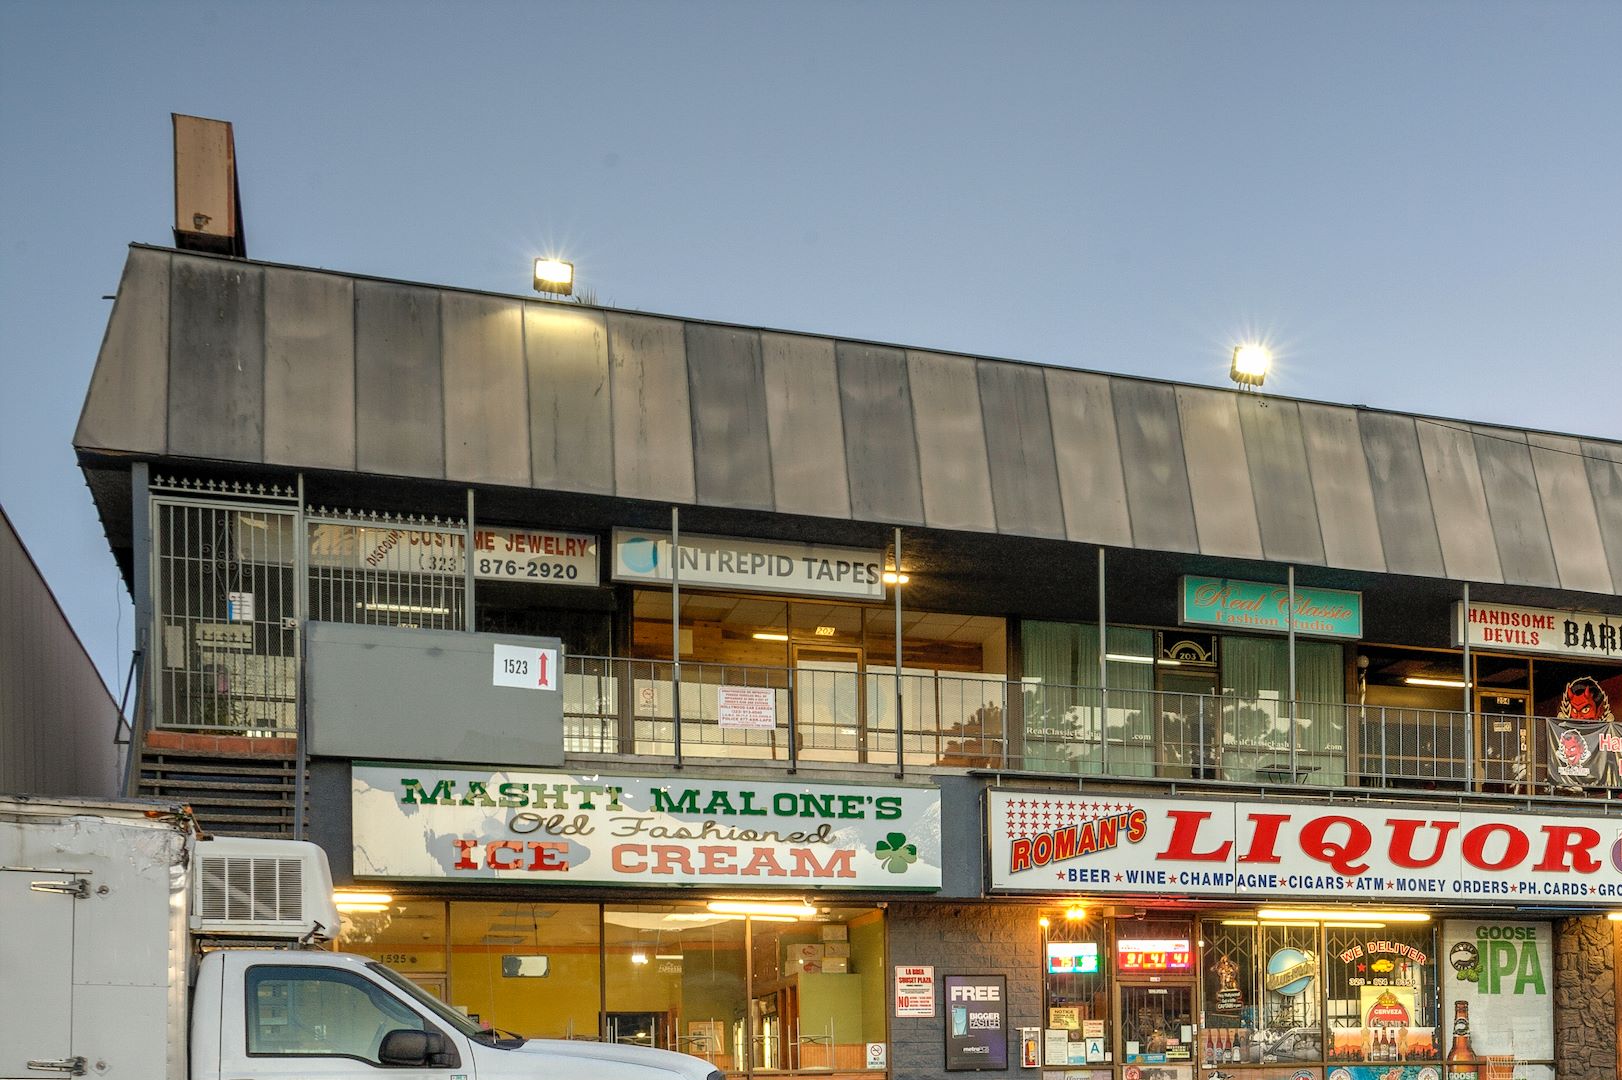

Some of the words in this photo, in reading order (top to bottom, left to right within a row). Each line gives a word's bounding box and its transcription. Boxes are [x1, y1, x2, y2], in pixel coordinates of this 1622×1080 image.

[505, 534, 588, 558] JEWELRY
[479, 558, 578, 580] 876-2920
[802, 556, 880, 585] TAPES
[1194, 582, 1267, 612] Real
[1271, 585, 1354, 622] Classic
[1215, 609, 1278, 625] Fashion
[1467, 608, 1555, 630] HANDSOME
[1483, 627, 1540, 646] DEVILS
[504, 659, 528, 675] 1523
[1179, 652, 1197, 661] 203
[401, 778, 623, 811] MASHTI
[650, 786, 902, 820] MALONE'S
[509, 812, 596, 836] Old
[609, 816, 837, 845] Fashioned
[1009, 808, 1147, 875] ROMAN'S
[1155, 810, 1602, 876] LIQUOR
[453, 839, 569, 872] ICE
[611, 843, 857, 878] CREAM
[1068, 868, 1111, 883] BEER
[1126, 870, 1166, 885] WINE
[1180, 871, 1277, 888] CHAMPAGNE
[1289, 875, 1344, 890] CIGARS
[1356, 877, 1384, 891] ATM
[1396, 878, 1446, 893] MONEY
[1453, 879, 1509, 894] ORDERS
[1476, 925, 1536, 940] GOOSE
[380, 954, 406, 964] 1525
[1340, 945, 1363, 964] WE
[1367, 940, 1427, 965] DELIVER
[1477, 940, 1546, 994] IPA
[898, 996, 909, 1008] NO
[950, 985, 1000, 1001] FREE
[969, 1012, 1000, 1020] BIGGER
[1090, 1042, 1100, 1054] A
